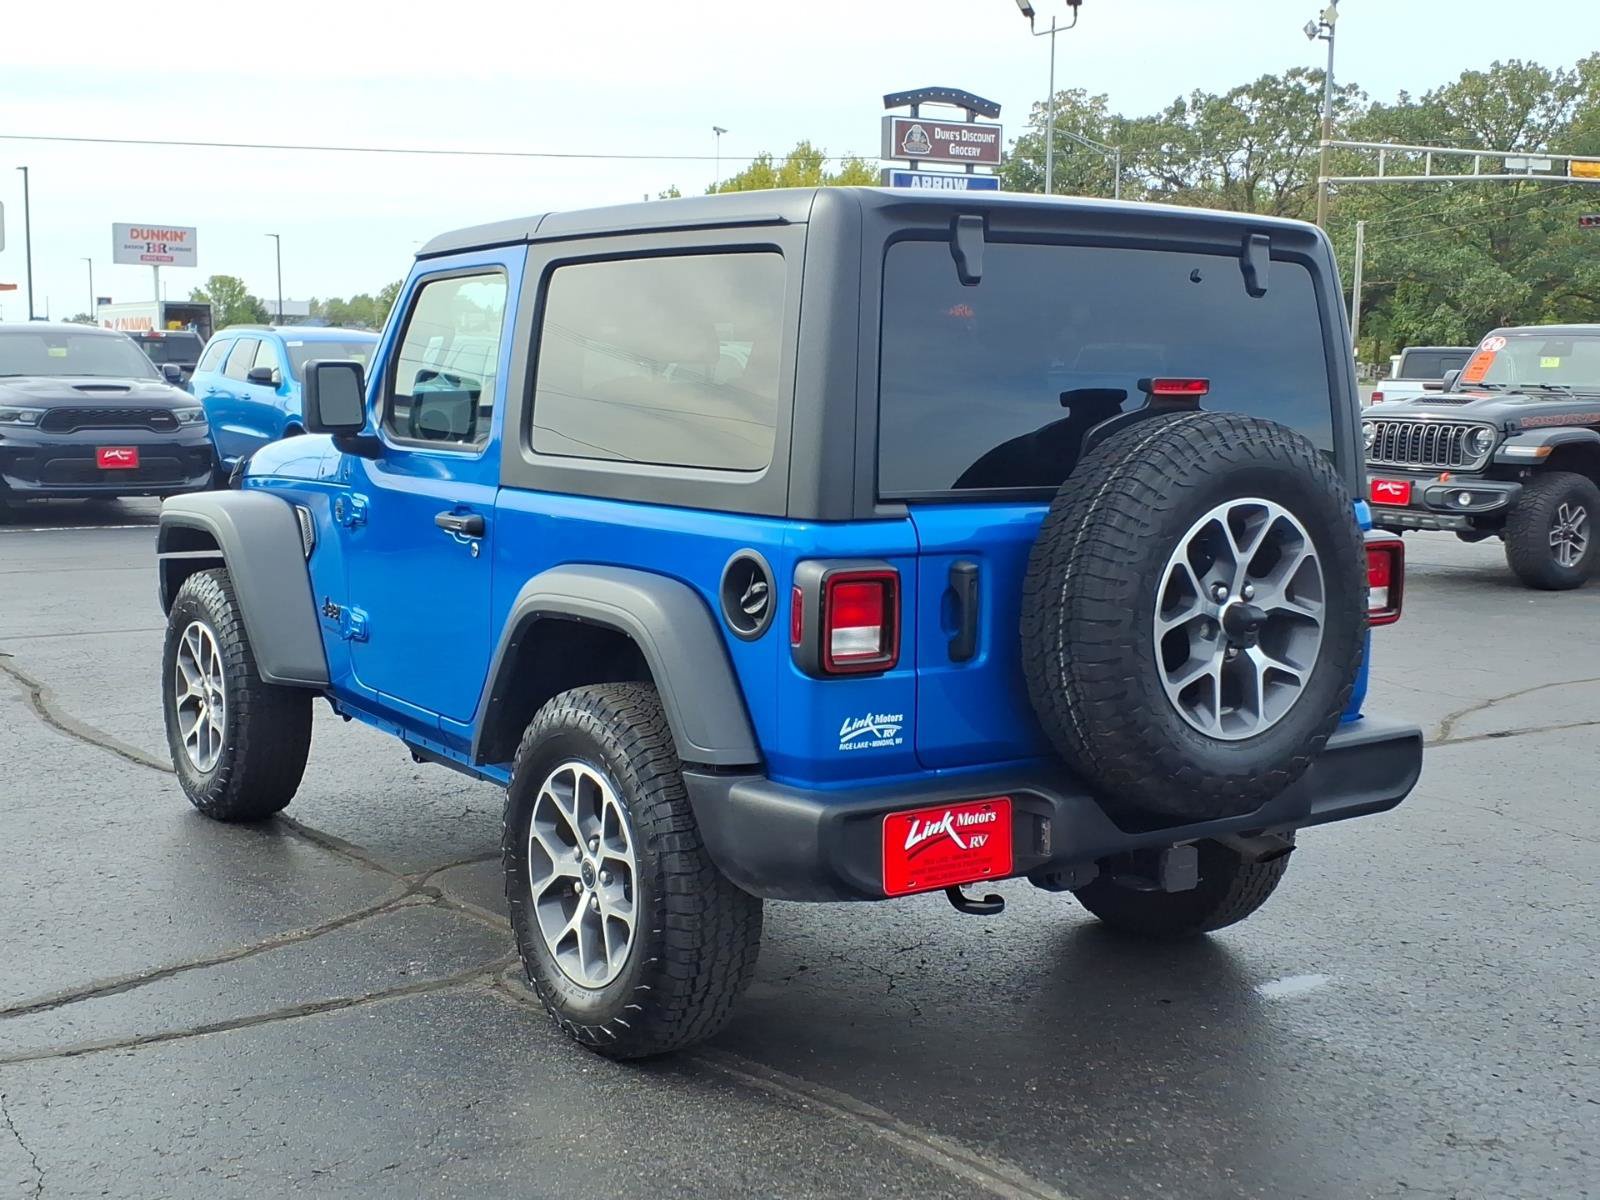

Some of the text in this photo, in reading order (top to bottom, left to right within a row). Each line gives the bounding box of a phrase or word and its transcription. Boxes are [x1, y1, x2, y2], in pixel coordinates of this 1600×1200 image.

[910, 175, 969, 191] ARROW
[130, 228, 187, 242] DUNKIN'
[839, 712, 904, 738] Link Motors
[883, 728, 897, 738] RV
[904, 811, 997, 851] Link Motors
[969, 834, 989, 849] RV
